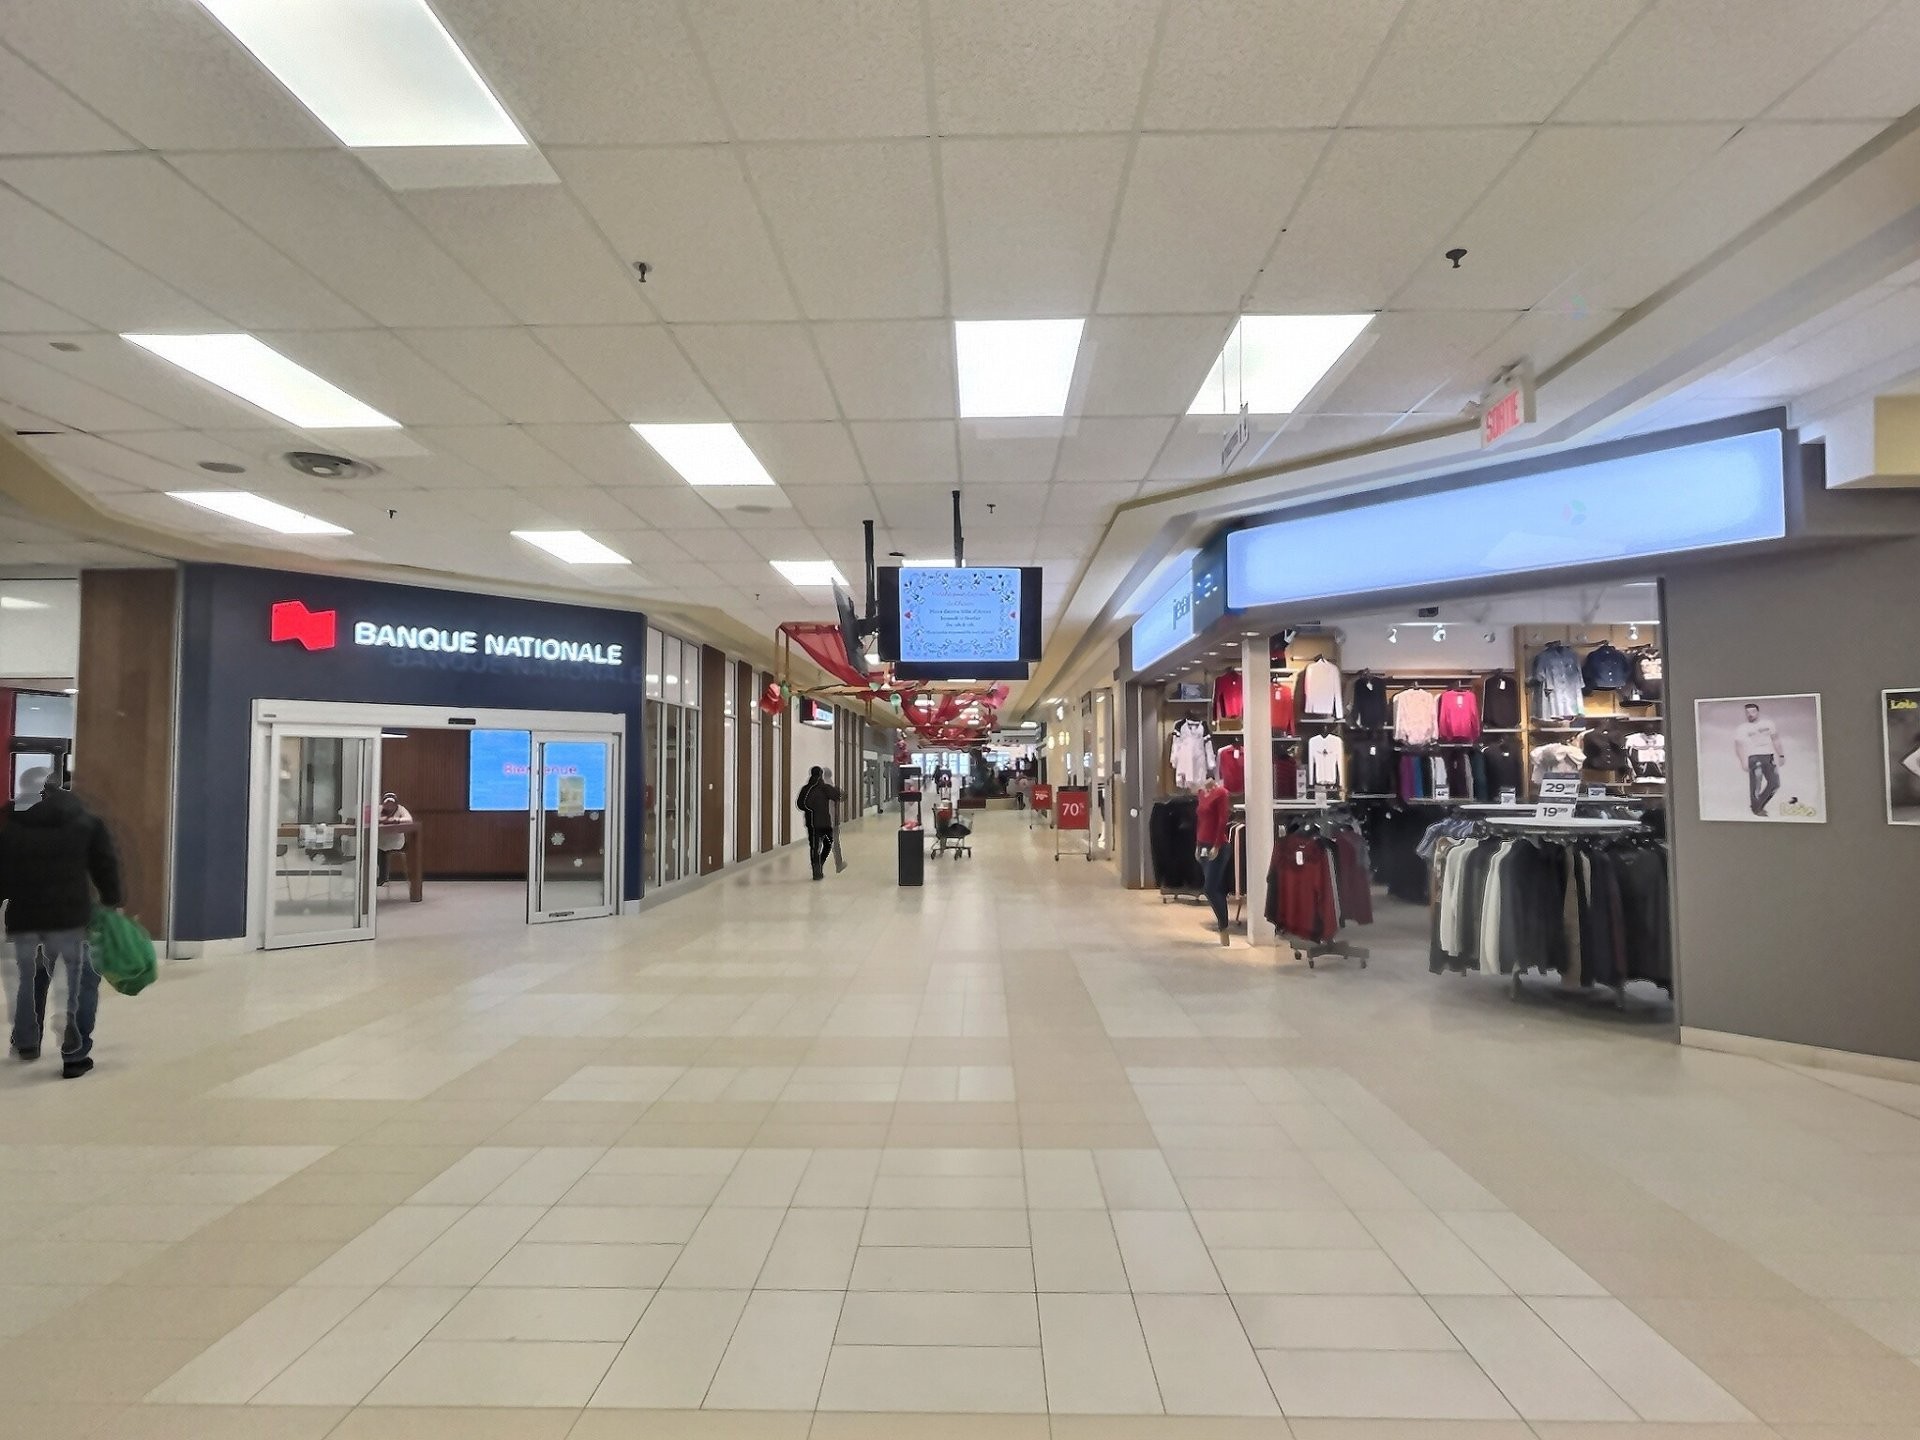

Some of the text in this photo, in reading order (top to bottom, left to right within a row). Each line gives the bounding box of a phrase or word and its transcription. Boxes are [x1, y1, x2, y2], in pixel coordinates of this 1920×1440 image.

[354, 621, 623, 666] BANQUE NATIONALE
[504, 761, 577, 775] Bienenue
